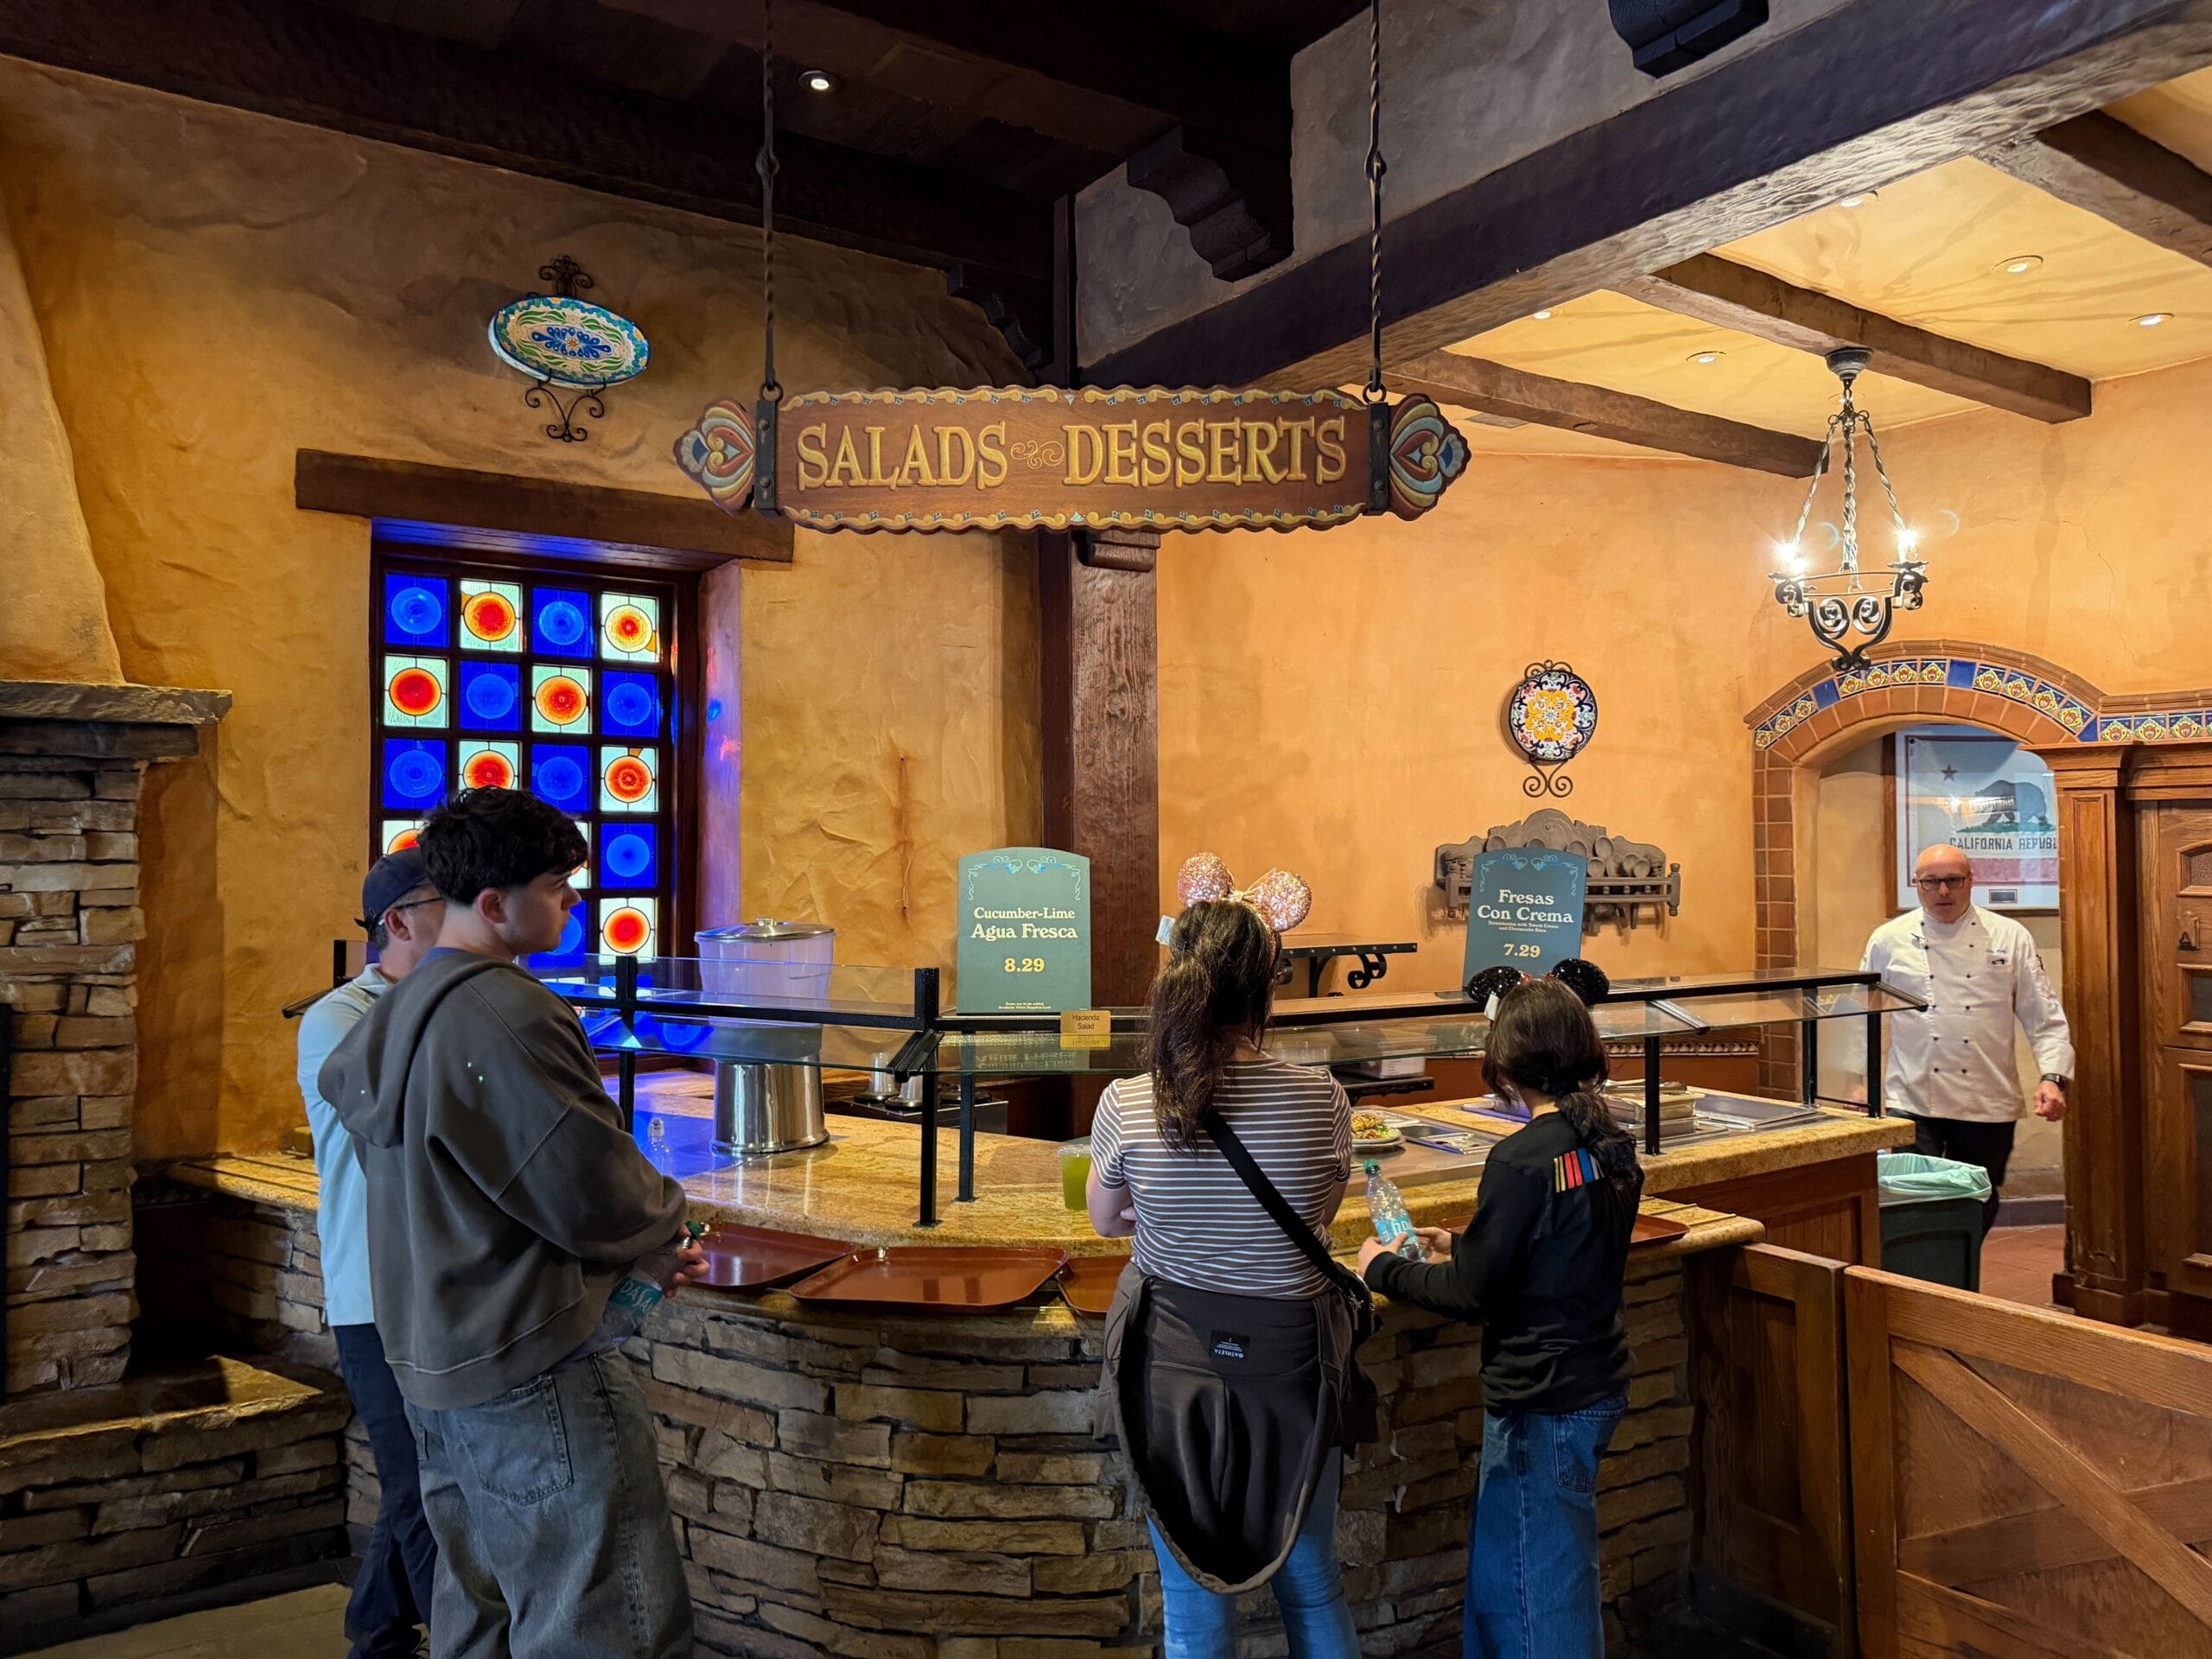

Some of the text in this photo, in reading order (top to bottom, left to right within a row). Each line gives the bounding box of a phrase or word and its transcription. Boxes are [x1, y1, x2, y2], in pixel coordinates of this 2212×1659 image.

[797, 416, 1348, 492] SALADS DESSERTS
[1949, 837, 2013, 850] CALIFORNIA
[1497, 889, 1554, 906] Fresas
[973, 906, 1076, 919] Cucumber-Lime
[1477, 905, 1574, 923] Con Crema
[970, 923, 1078, 942] Agua Fresca
[1503, 943, 1541, 957] 7.29
[1004, 957, 1045, 972] 8.29
